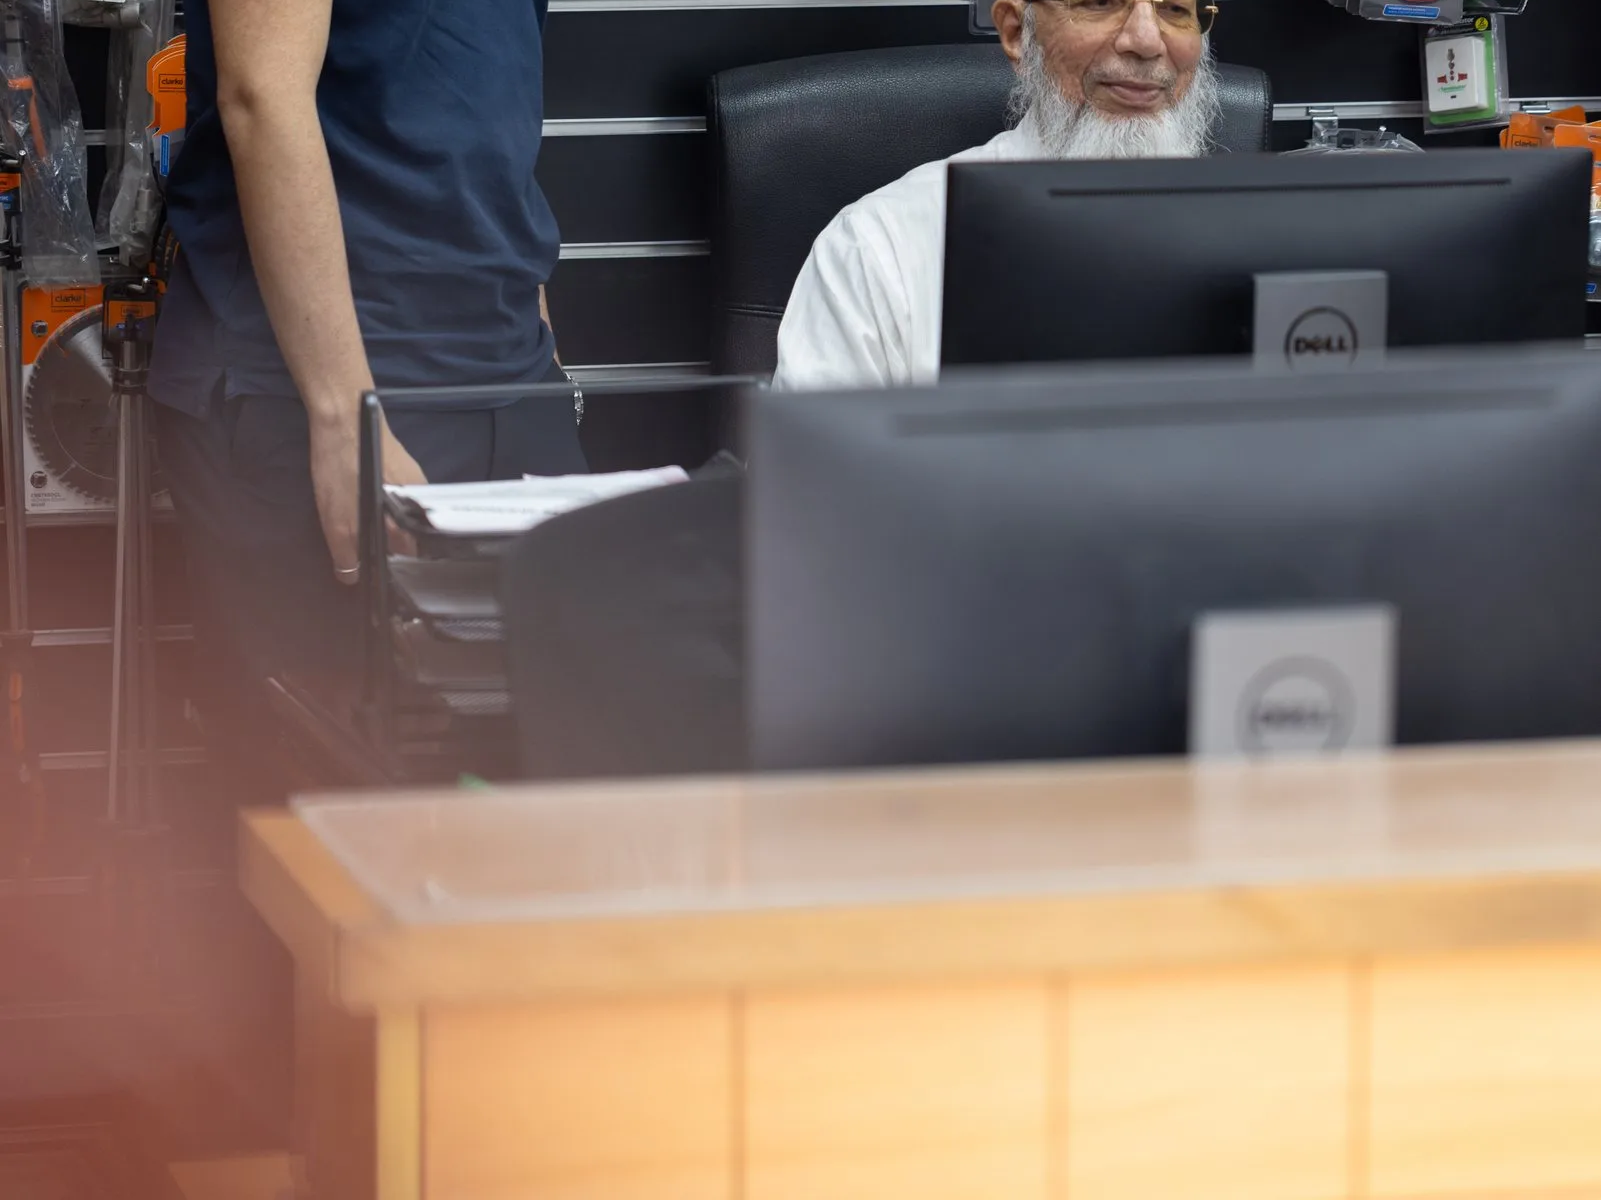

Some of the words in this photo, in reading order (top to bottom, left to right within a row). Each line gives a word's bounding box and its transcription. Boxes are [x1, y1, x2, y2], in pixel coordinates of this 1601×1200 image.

[160, 77, 184, 86] clarke
[54, 294, 83, 305] clarke
[1294, 335, 1348, 354] DELL
